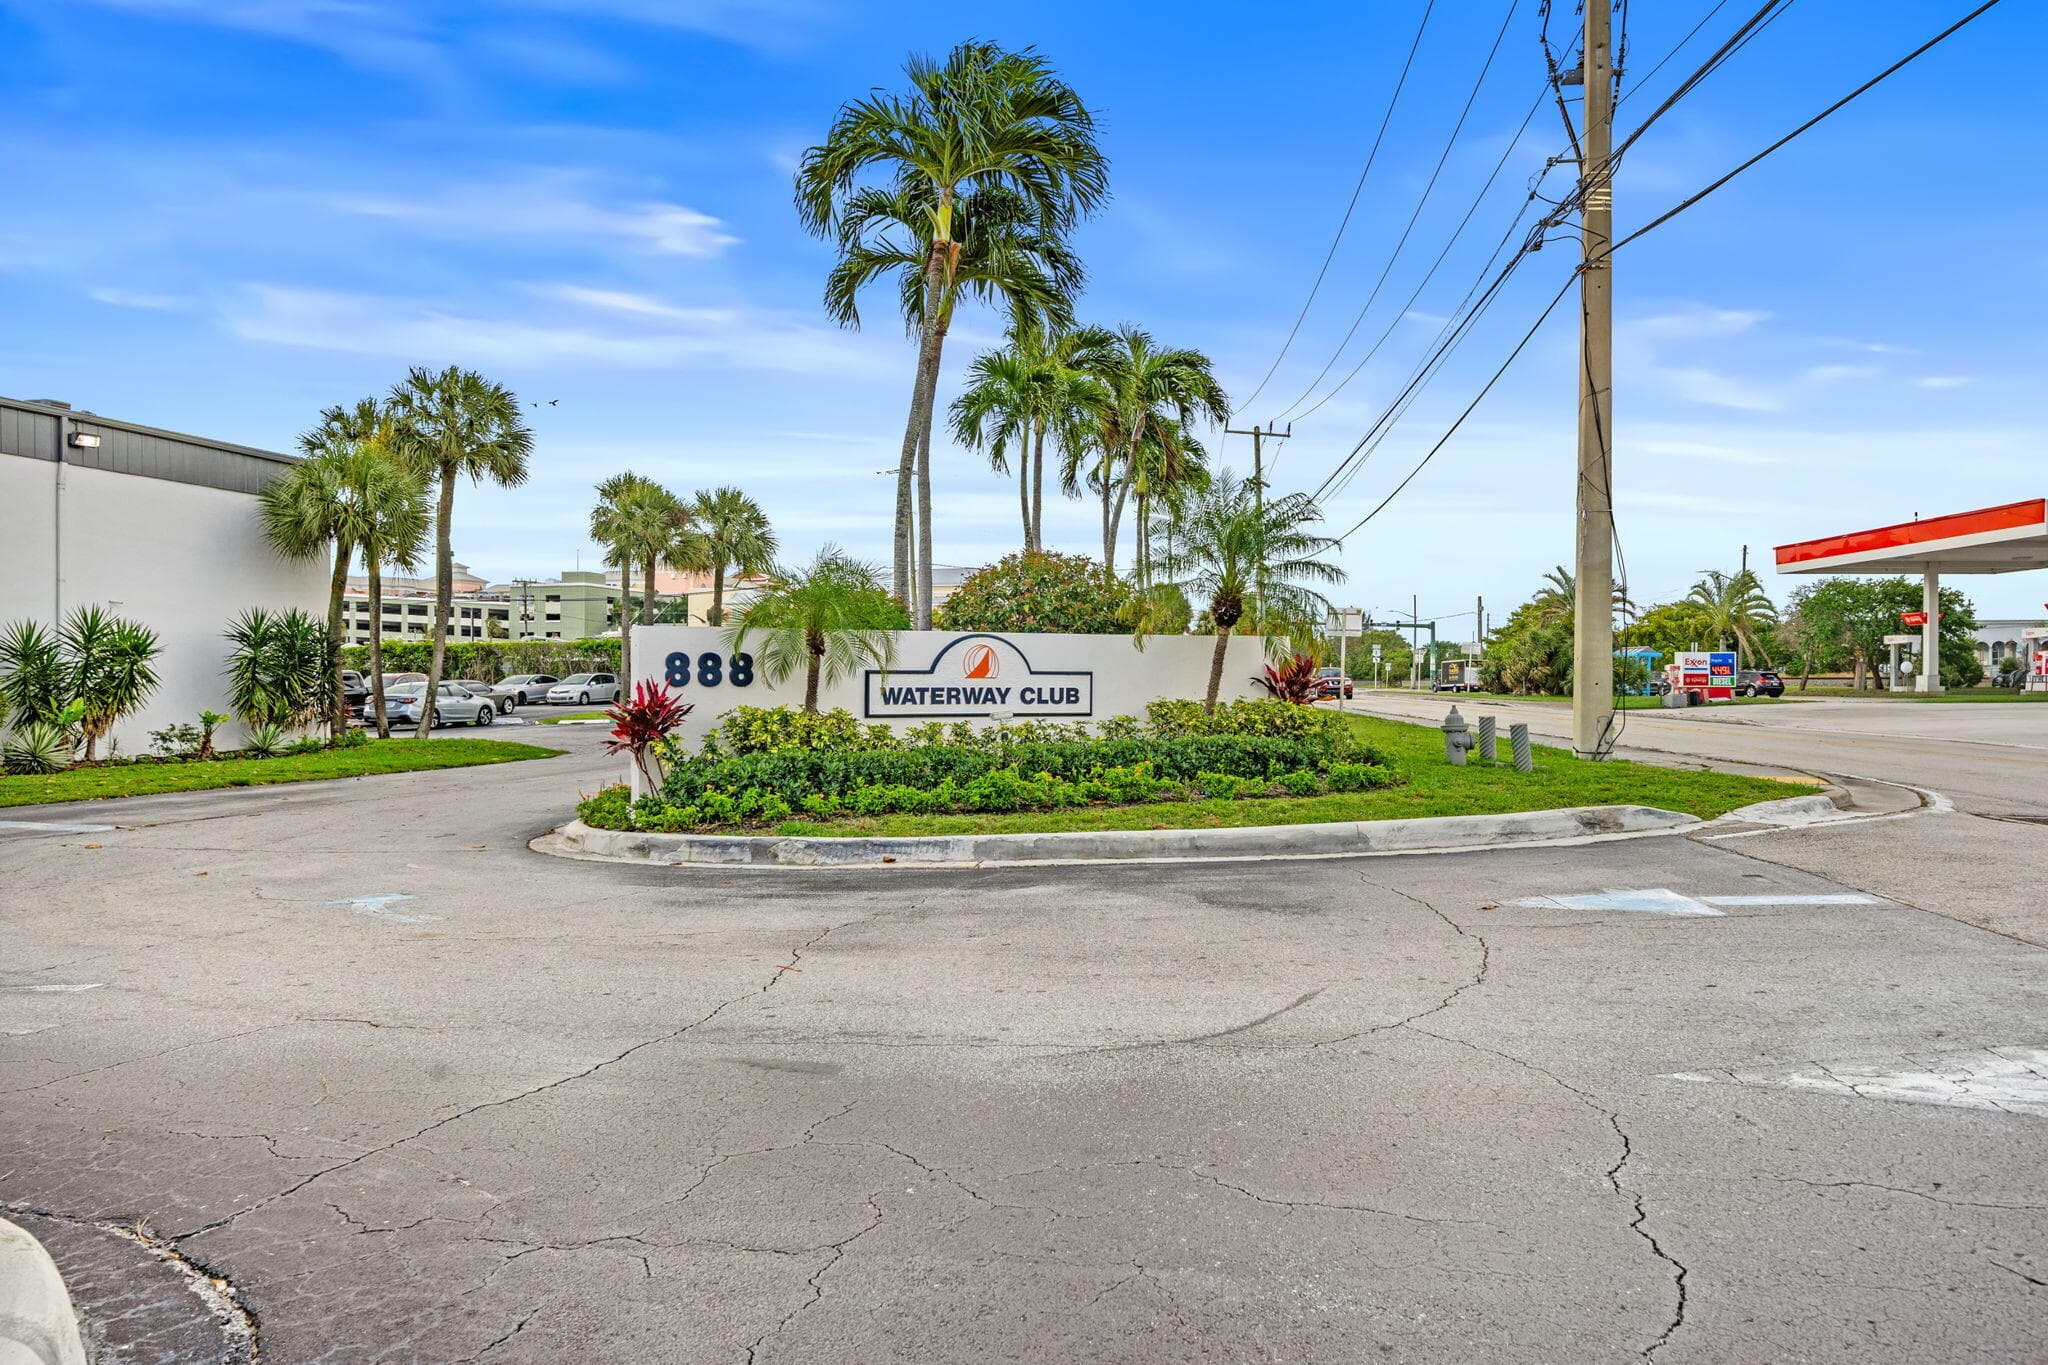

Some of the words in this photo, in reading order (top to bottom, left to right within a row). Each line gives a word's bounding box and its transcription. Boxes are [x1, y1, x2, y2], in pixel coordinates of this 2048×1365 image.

[665, 651, 754, 688] 888
[1684, 658, 1708, 667] Exxon
[881, 687, 1012, 705] WATERWAY
[1019, 687, 1080, 705] CLUB
